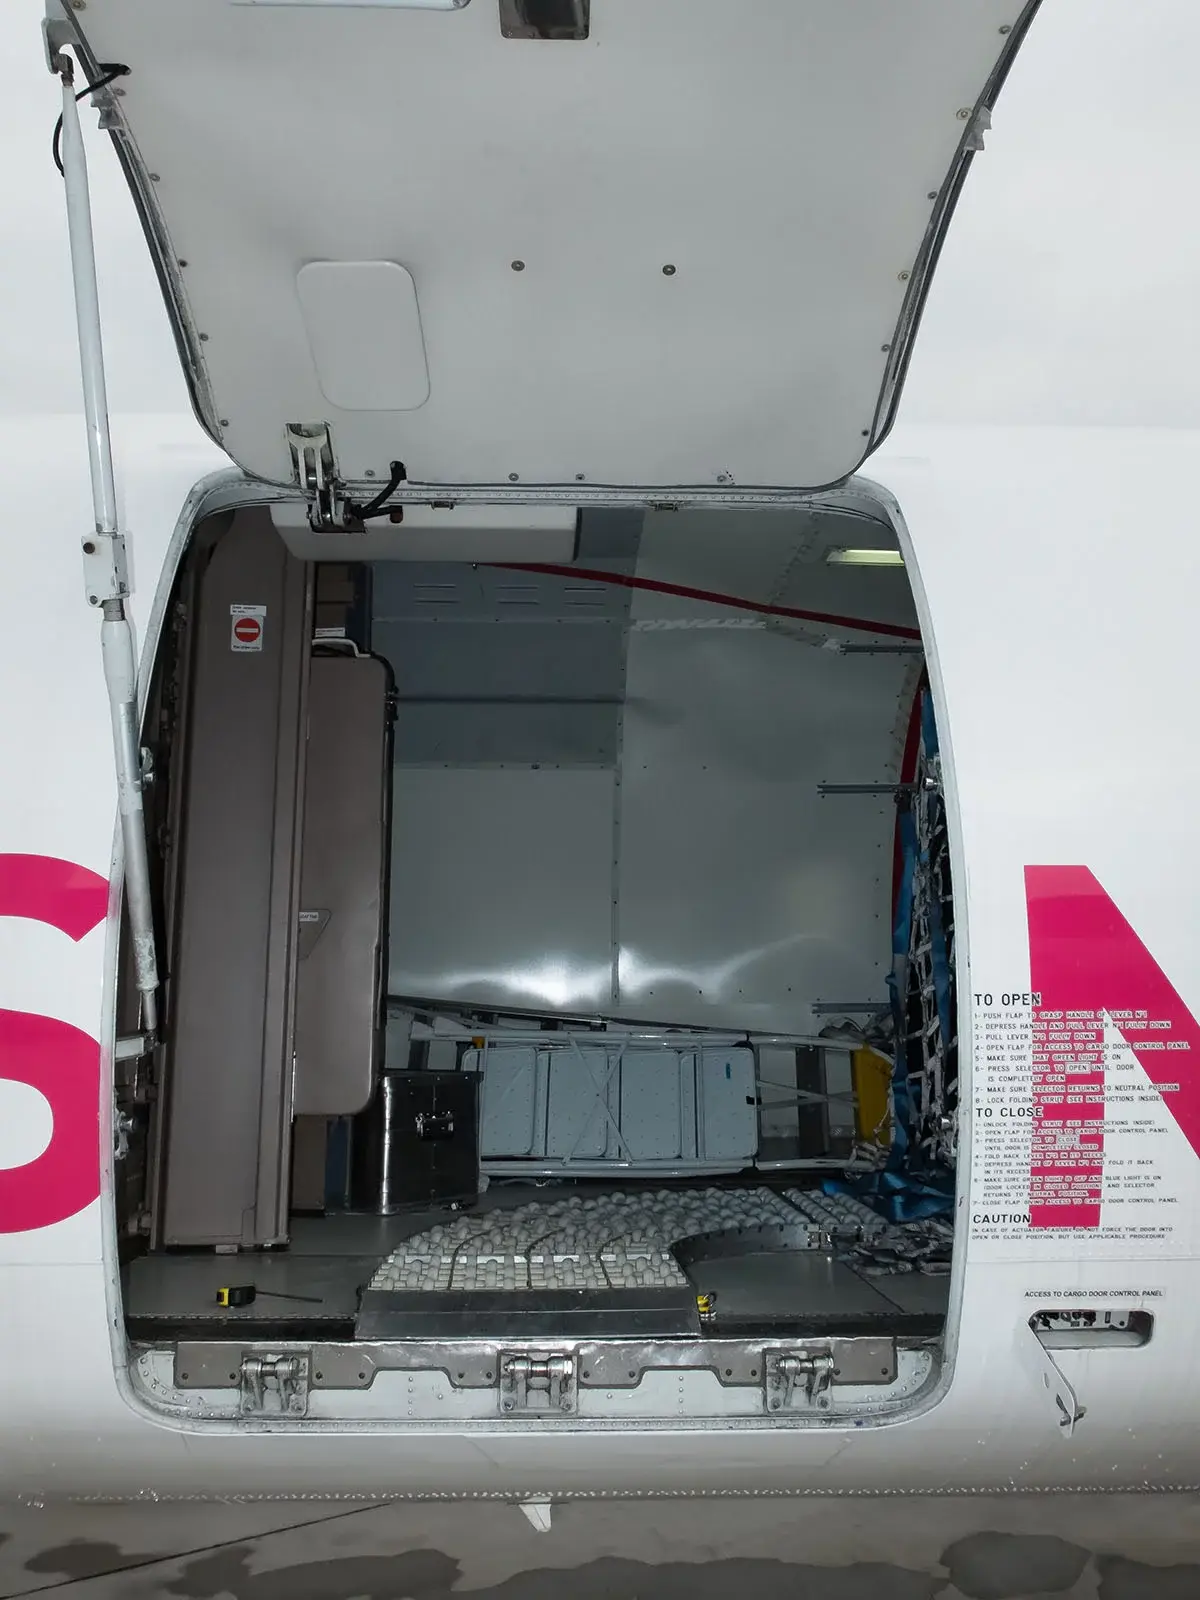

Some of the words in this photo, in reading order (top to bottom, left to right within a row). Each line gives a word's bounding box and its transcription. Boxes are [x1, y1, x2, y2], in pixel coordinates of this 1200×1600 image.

[974, 994, 993, 1006] TO
[1002, 993, 1041, 1006] OPEN
[976, 1108, 993, 1117] TO
[1001, 1107, 1043, 1117] CLOSE
[973, 1214, 1031, 1224] CAUTION
